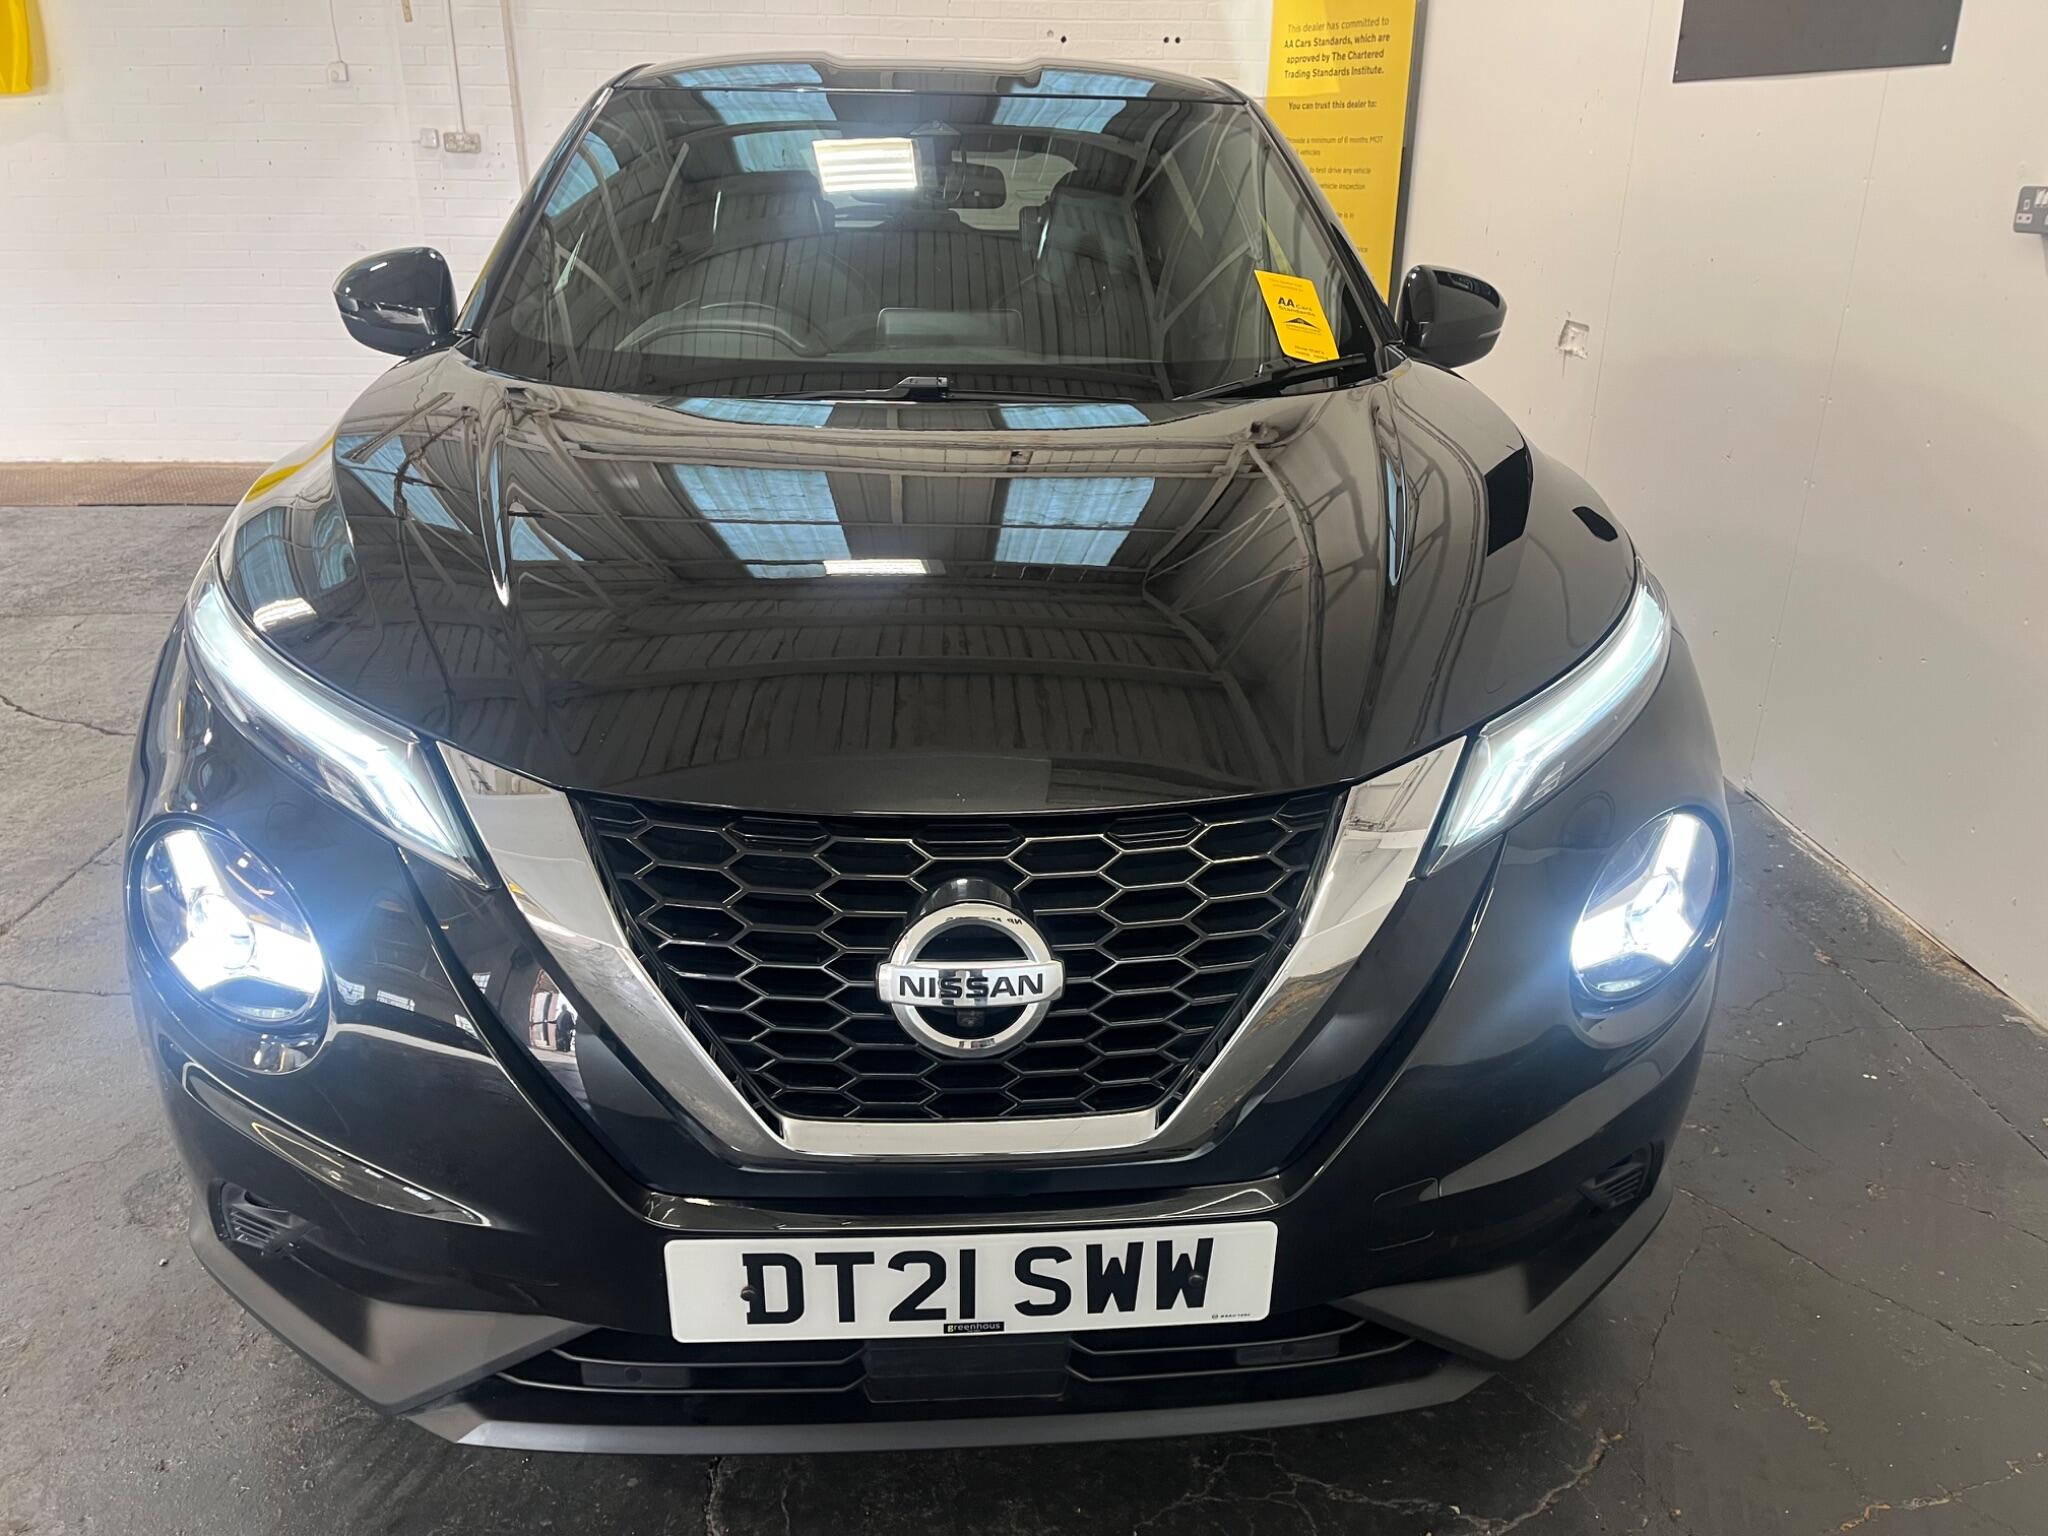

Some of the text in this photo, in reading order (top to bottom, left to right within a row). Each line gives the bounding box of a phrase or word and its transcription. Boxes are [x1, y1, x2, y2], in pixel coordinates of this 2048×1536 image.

[1288, 17, 1390, 33] This dealer has committed to
[1284, 33, 1390, 48] AA Cars Standards, which are
[1286, 49, 1384, 64] approved by The Chartered
[1284, 65, 1384, 79] Trading Standards Institute.
[1289, 102, 1300, 110] You
[1315, 101, 1330, 109] trust
[1332, 100, 1345, 109] this
[1346, 100, 1366, 108] dealer
[1278, 297, 1294, 307] AA
[900, 973, 1043, 999] NISSAN
[742, 1238, 1214, 1325] DT21 SWW
[947, 1322, 1001, 1333] greenhous
